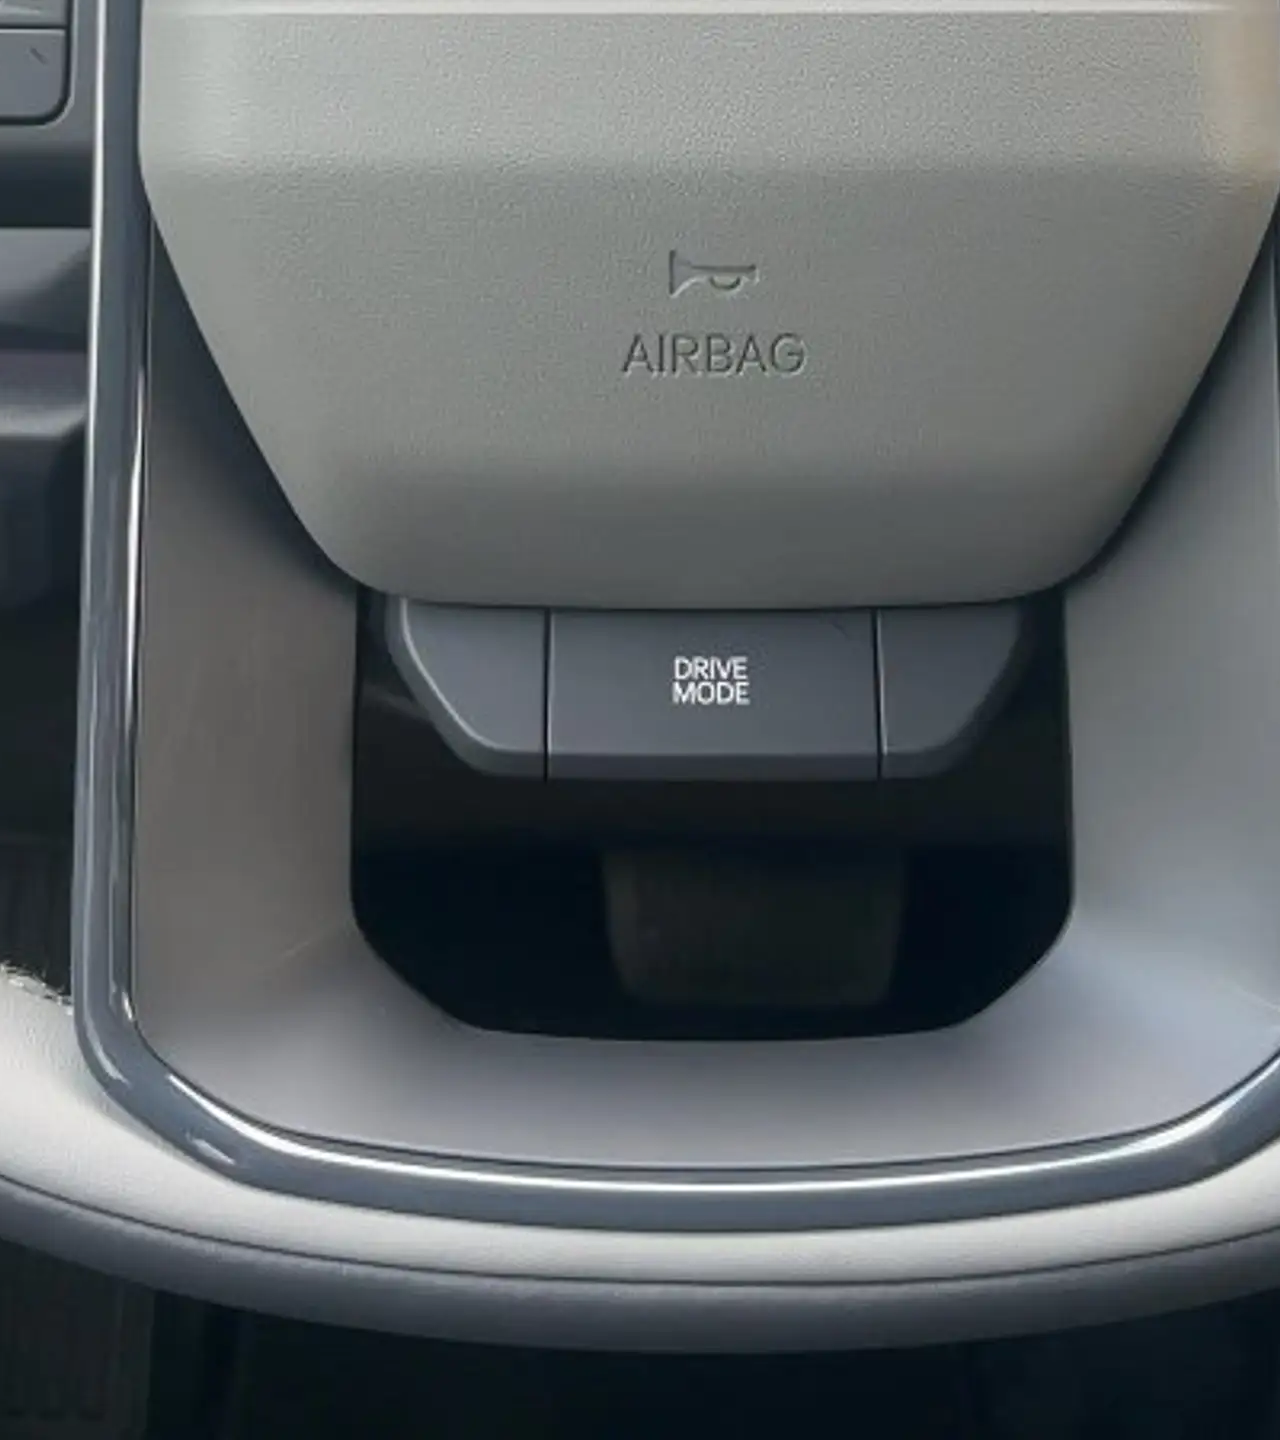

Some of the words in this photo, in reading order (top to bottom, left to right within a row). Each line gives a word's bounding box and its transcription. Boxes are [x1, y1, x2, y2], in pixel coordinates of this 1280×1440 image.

[621, 333, 806, 375] AIRBAG
[673, 657, 749, 681] DRIVE
[672, 681, 750, 706] MODE
